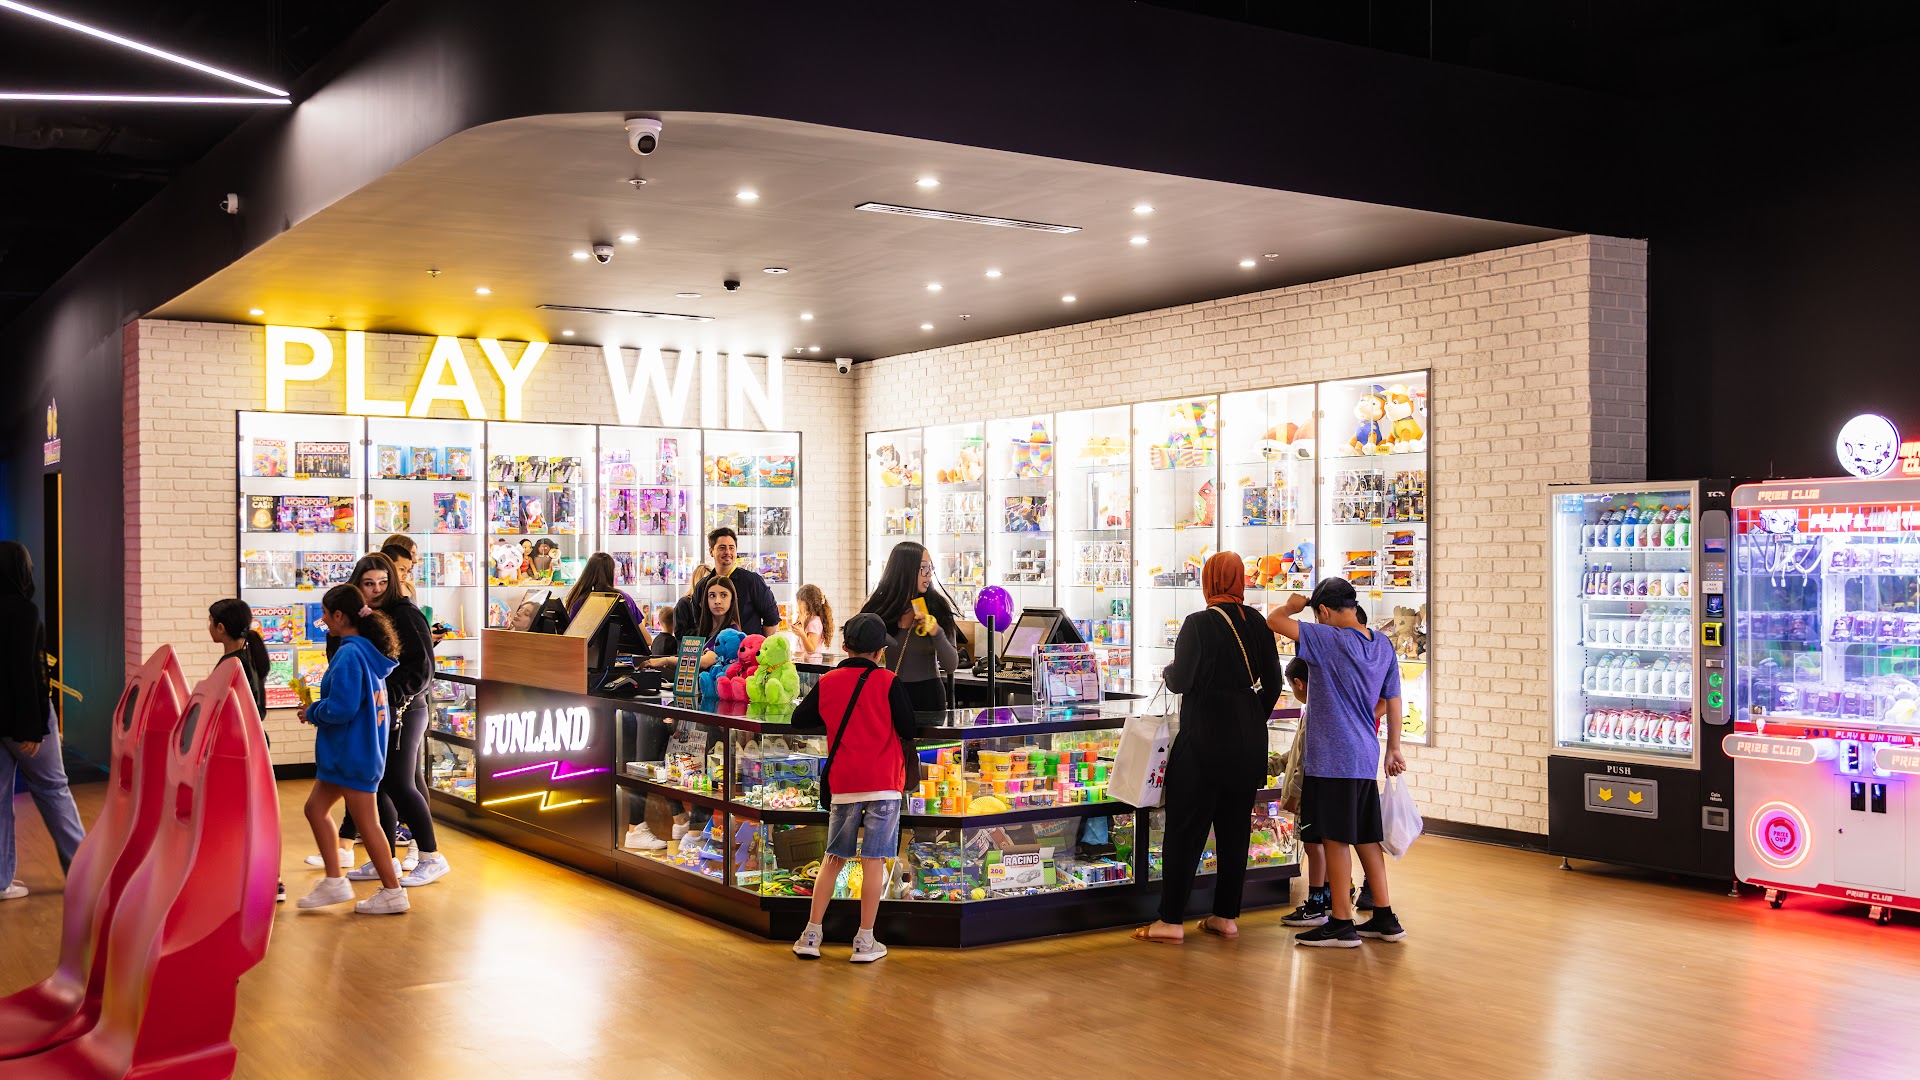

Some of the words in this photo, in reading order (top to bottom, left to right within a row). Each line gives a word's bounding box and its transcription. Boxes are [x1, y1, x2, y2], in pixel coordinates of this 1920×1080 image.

[265, 325, 549, 421] PLAY
[602, 345, 783, 430] WIN
[301, 444, 347, 453] MONOPOLY
[1758, 490, 1788, 502] PRIZE
[1791, 489, 1820, 500] CLUB
[252, 501, 274, 509] CASH
[306, 553, 354, 562] MONOPOLY
[483, 707, 591, 755] FUNLAND
[1835, 731, 1858, 740] PLAY
[1868, 733, 1884, 742] WIN
[1887, 735, 1906, 743] TWIN
[1737, 741, 1769, 754] PRIZE
[1772, 745, 1801, 756] CLUB
[1607, 765, 1631, 775] PUSH
[1004, 854, 1039, 867] RACING
[1846, 889, 1869, 899] PRIZE
[1872, 892, 1893, 902] CLUB
